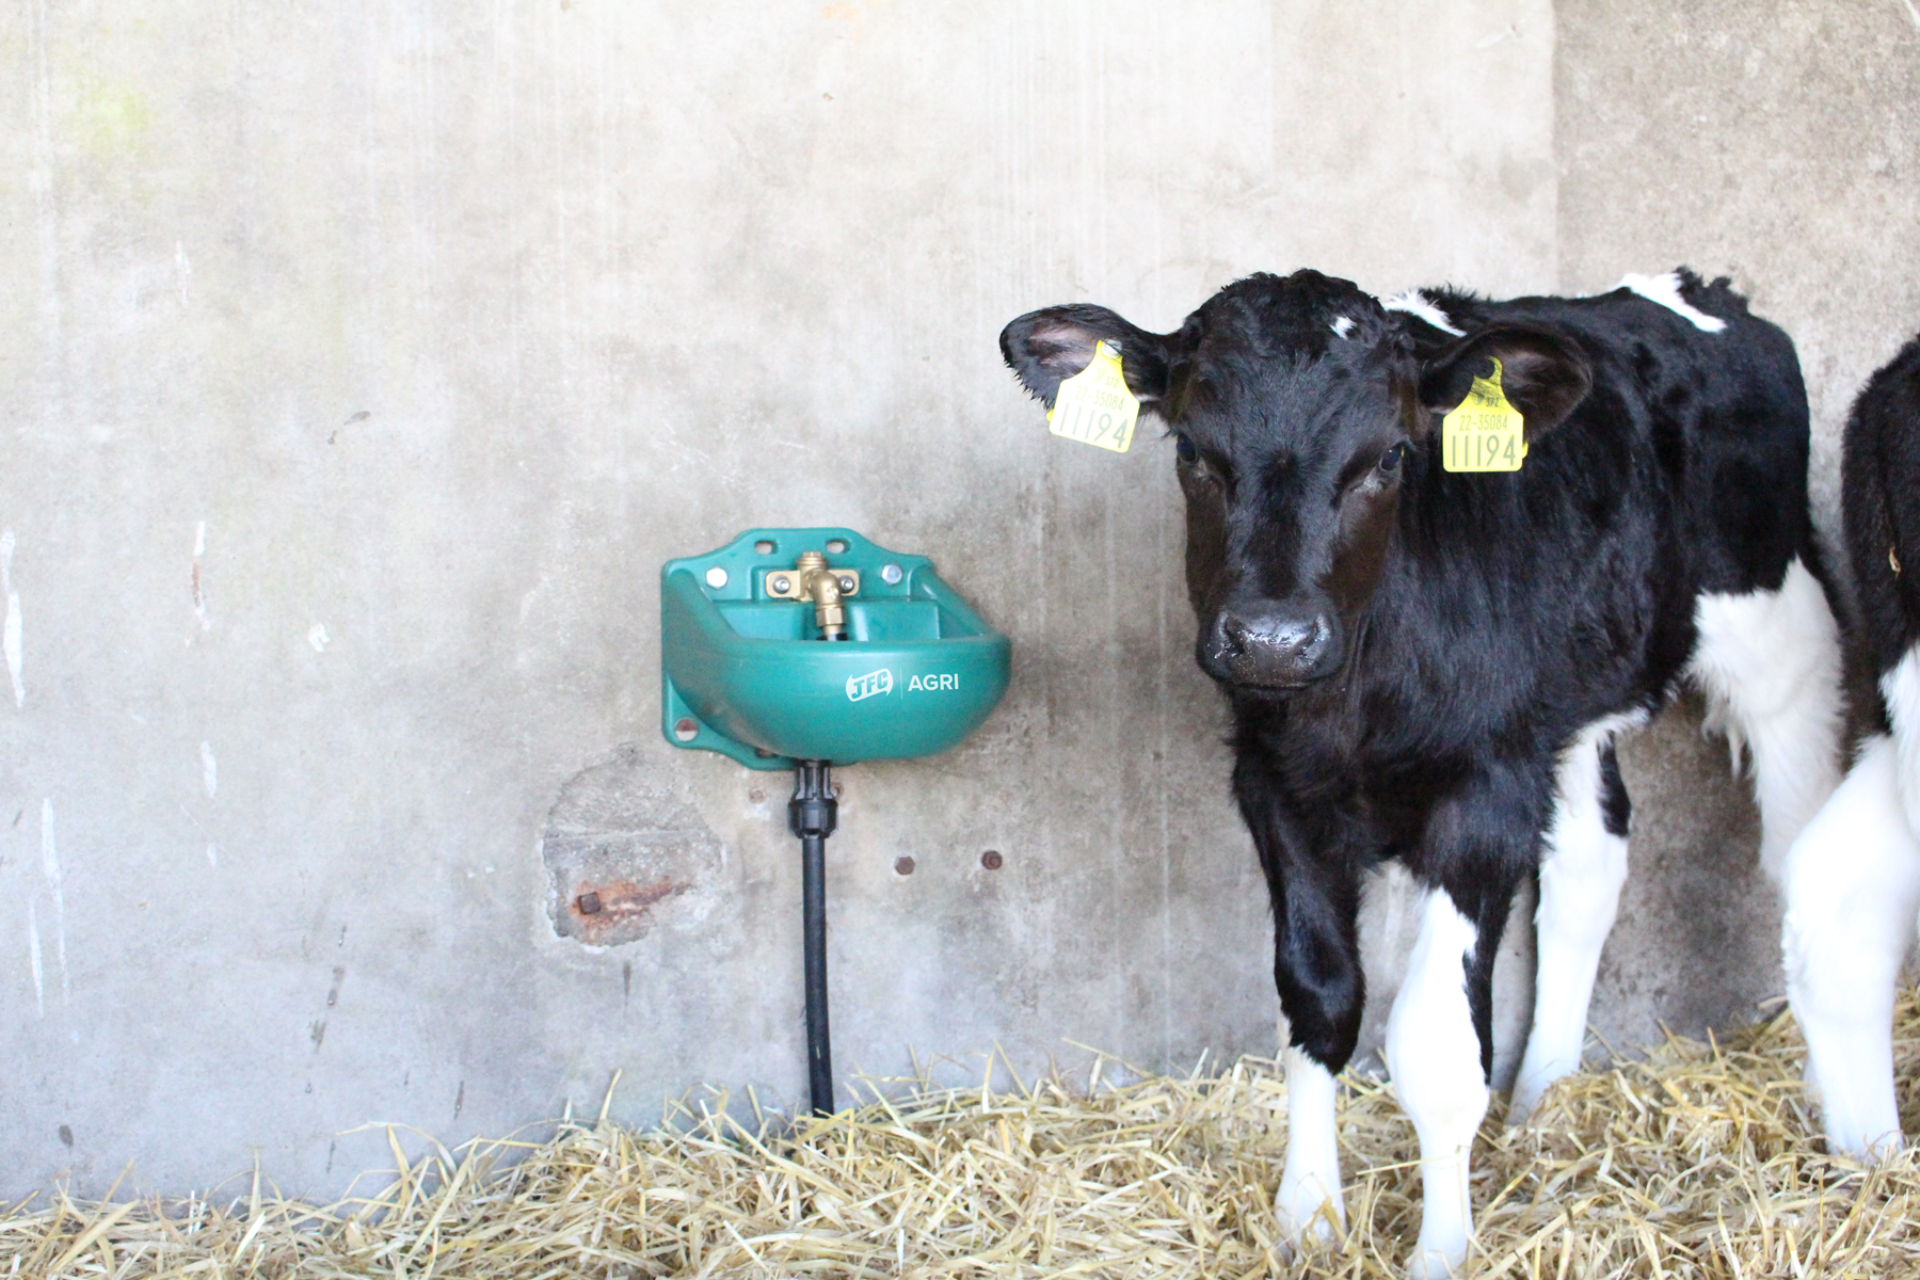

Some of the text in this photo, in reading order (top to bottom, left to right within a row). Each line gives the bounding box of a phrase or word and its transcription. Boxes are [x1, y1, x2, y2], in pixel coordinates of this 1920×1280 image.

[1074, 385, 1125, 412] 22-35084
[1059, 402, 1128, 449] 11194
[1459, 414, 1508, 431] 22-35084
[1452, 434, 1516, 467] 11194
[850, 670, 959, 700] JFC AGRI
